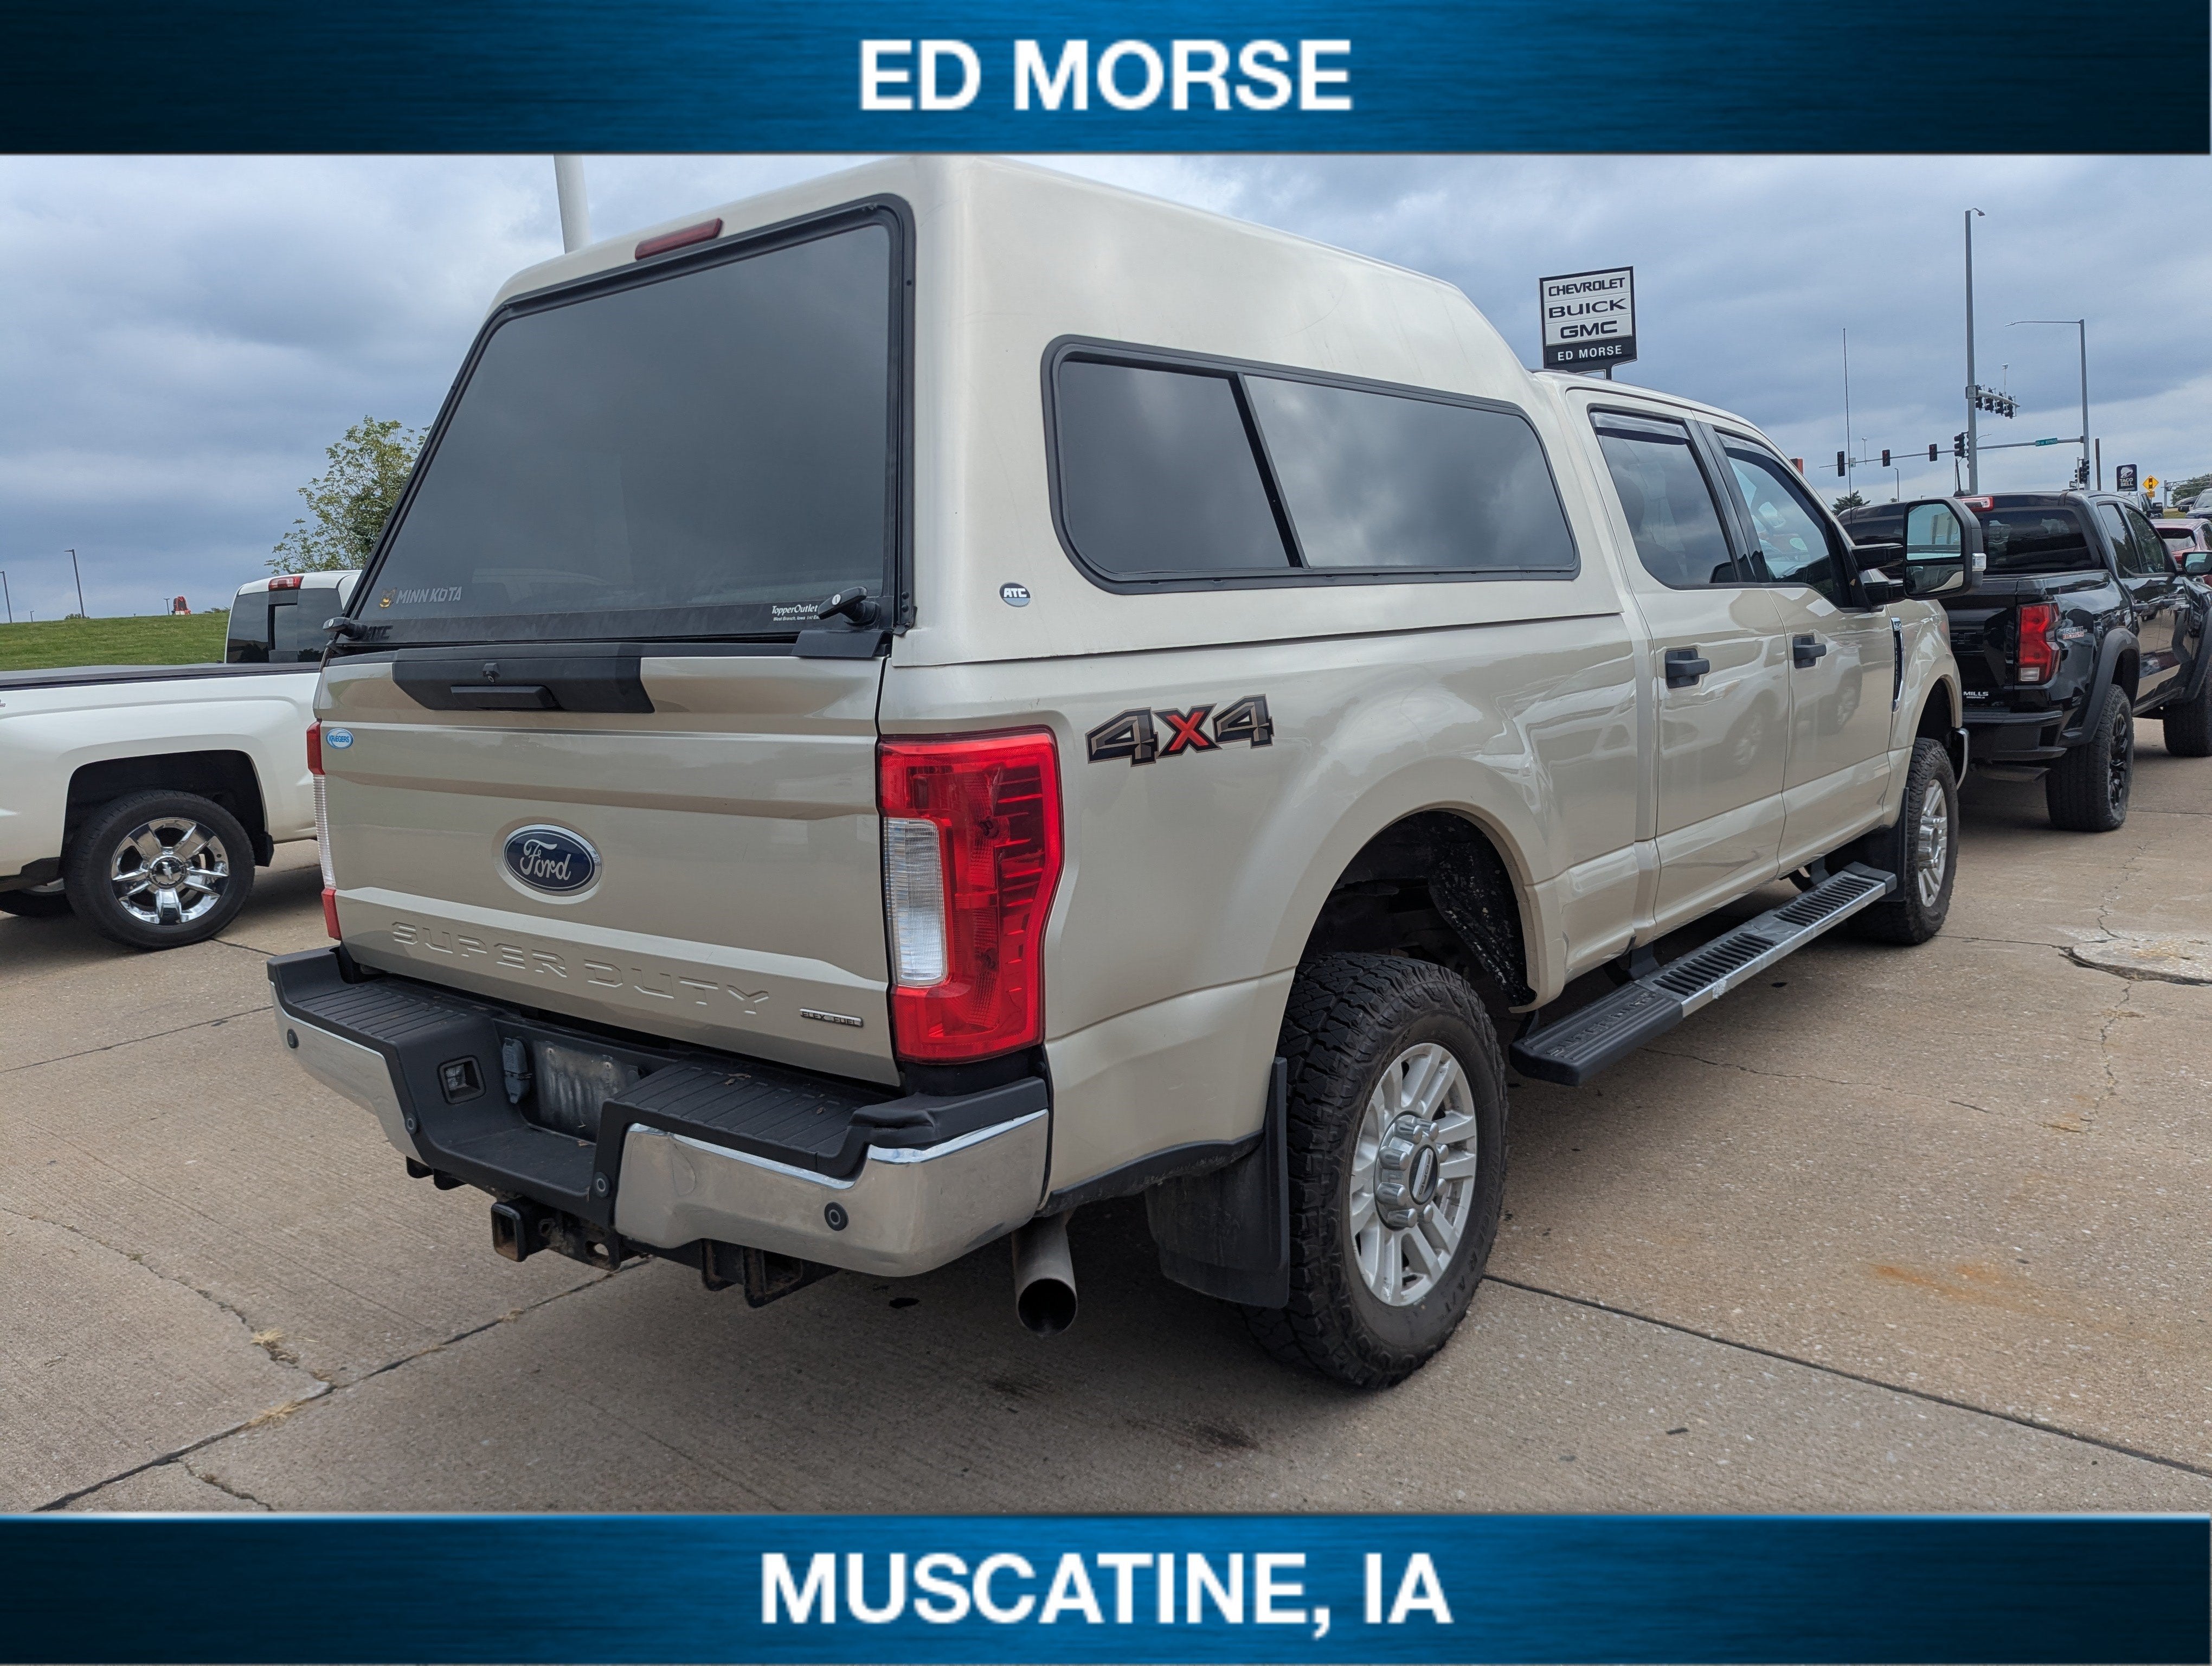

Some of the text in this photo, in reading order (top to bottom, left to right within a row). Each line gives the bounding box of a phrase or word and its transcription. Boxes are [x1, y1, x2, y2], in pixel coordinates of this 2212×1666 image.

[1548, 277, 1625, 297] CHEVROLET
[1549, 298, 1627, 318] BUICK
[1560, 320, 1617, 339] GMC
[1558, 345, 1622, 361] ED MORSE
[396, 586, 462, 604] MINN KOTA
[1004, 587, 1027, 598] ATC
[771, 604, 818, 616] TopperOutlet
[2062, 631, 2084, 640] BOSS
[329, 735, 350, 743] KRIEGERS
[519, 838, 571, 881] Ford
[391, 921, 770, 1015] SUPER DUTY
[801, 1011, 861, 1027] FLEX FUEL
[1419, 1154, 1431, 1195] FORD
